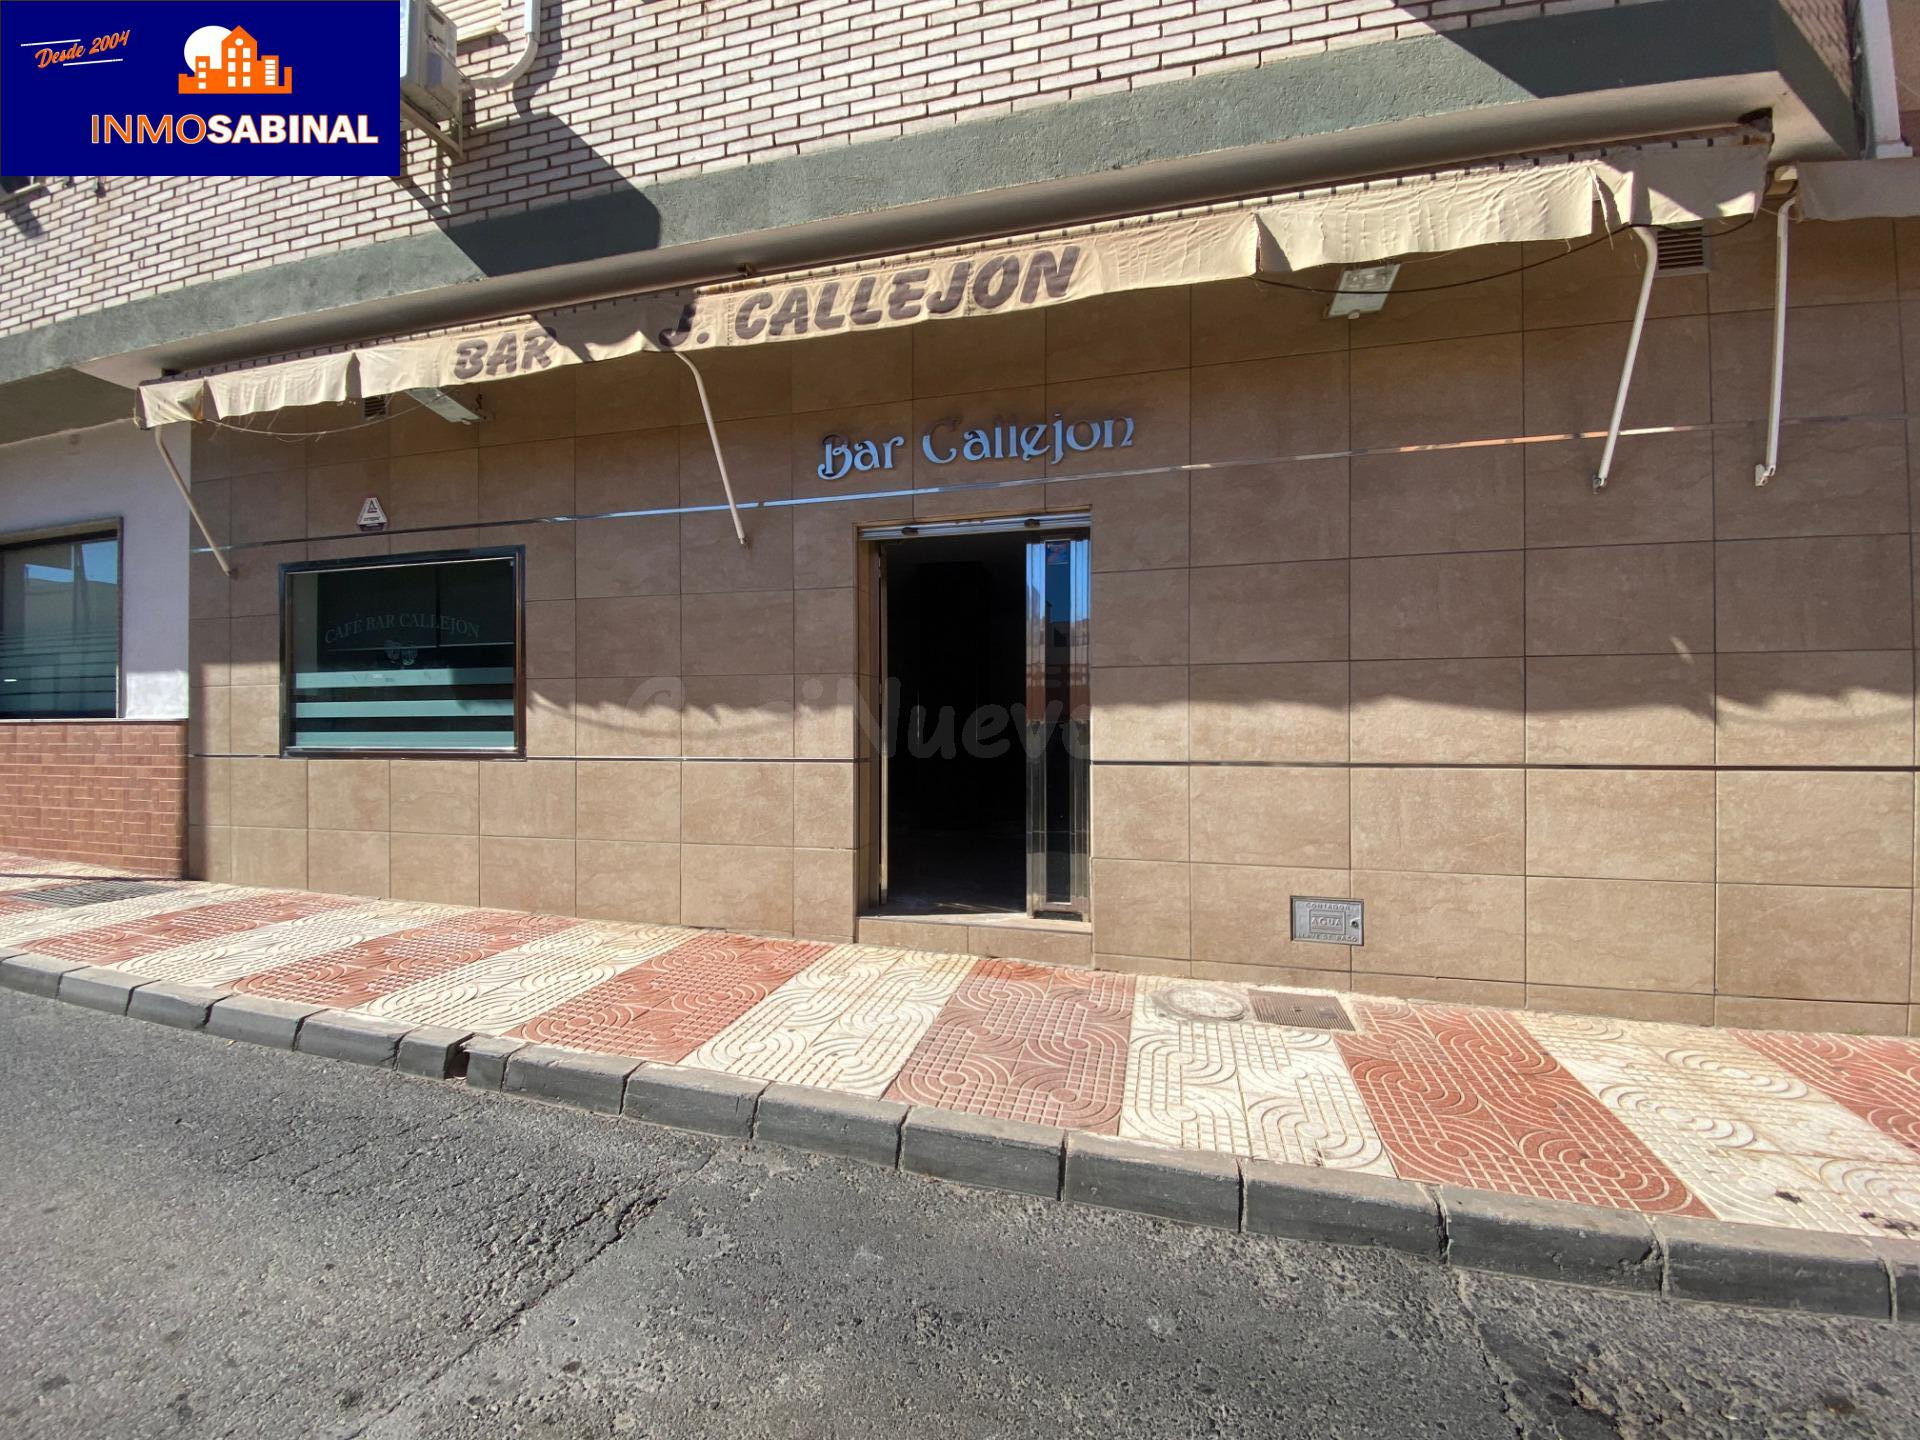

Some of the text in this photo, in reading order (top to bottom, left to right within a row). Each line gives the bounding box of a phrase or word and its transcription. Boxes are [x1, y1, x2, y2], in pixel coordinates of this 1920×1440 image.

[454, 245, 1081, 381] BAR J. CALLEJON
[817, 412, 1135, 481] Bar Callejon
[366, 615, 397, 633] BAR
[1311, 916, 1342, 927] AGUA
